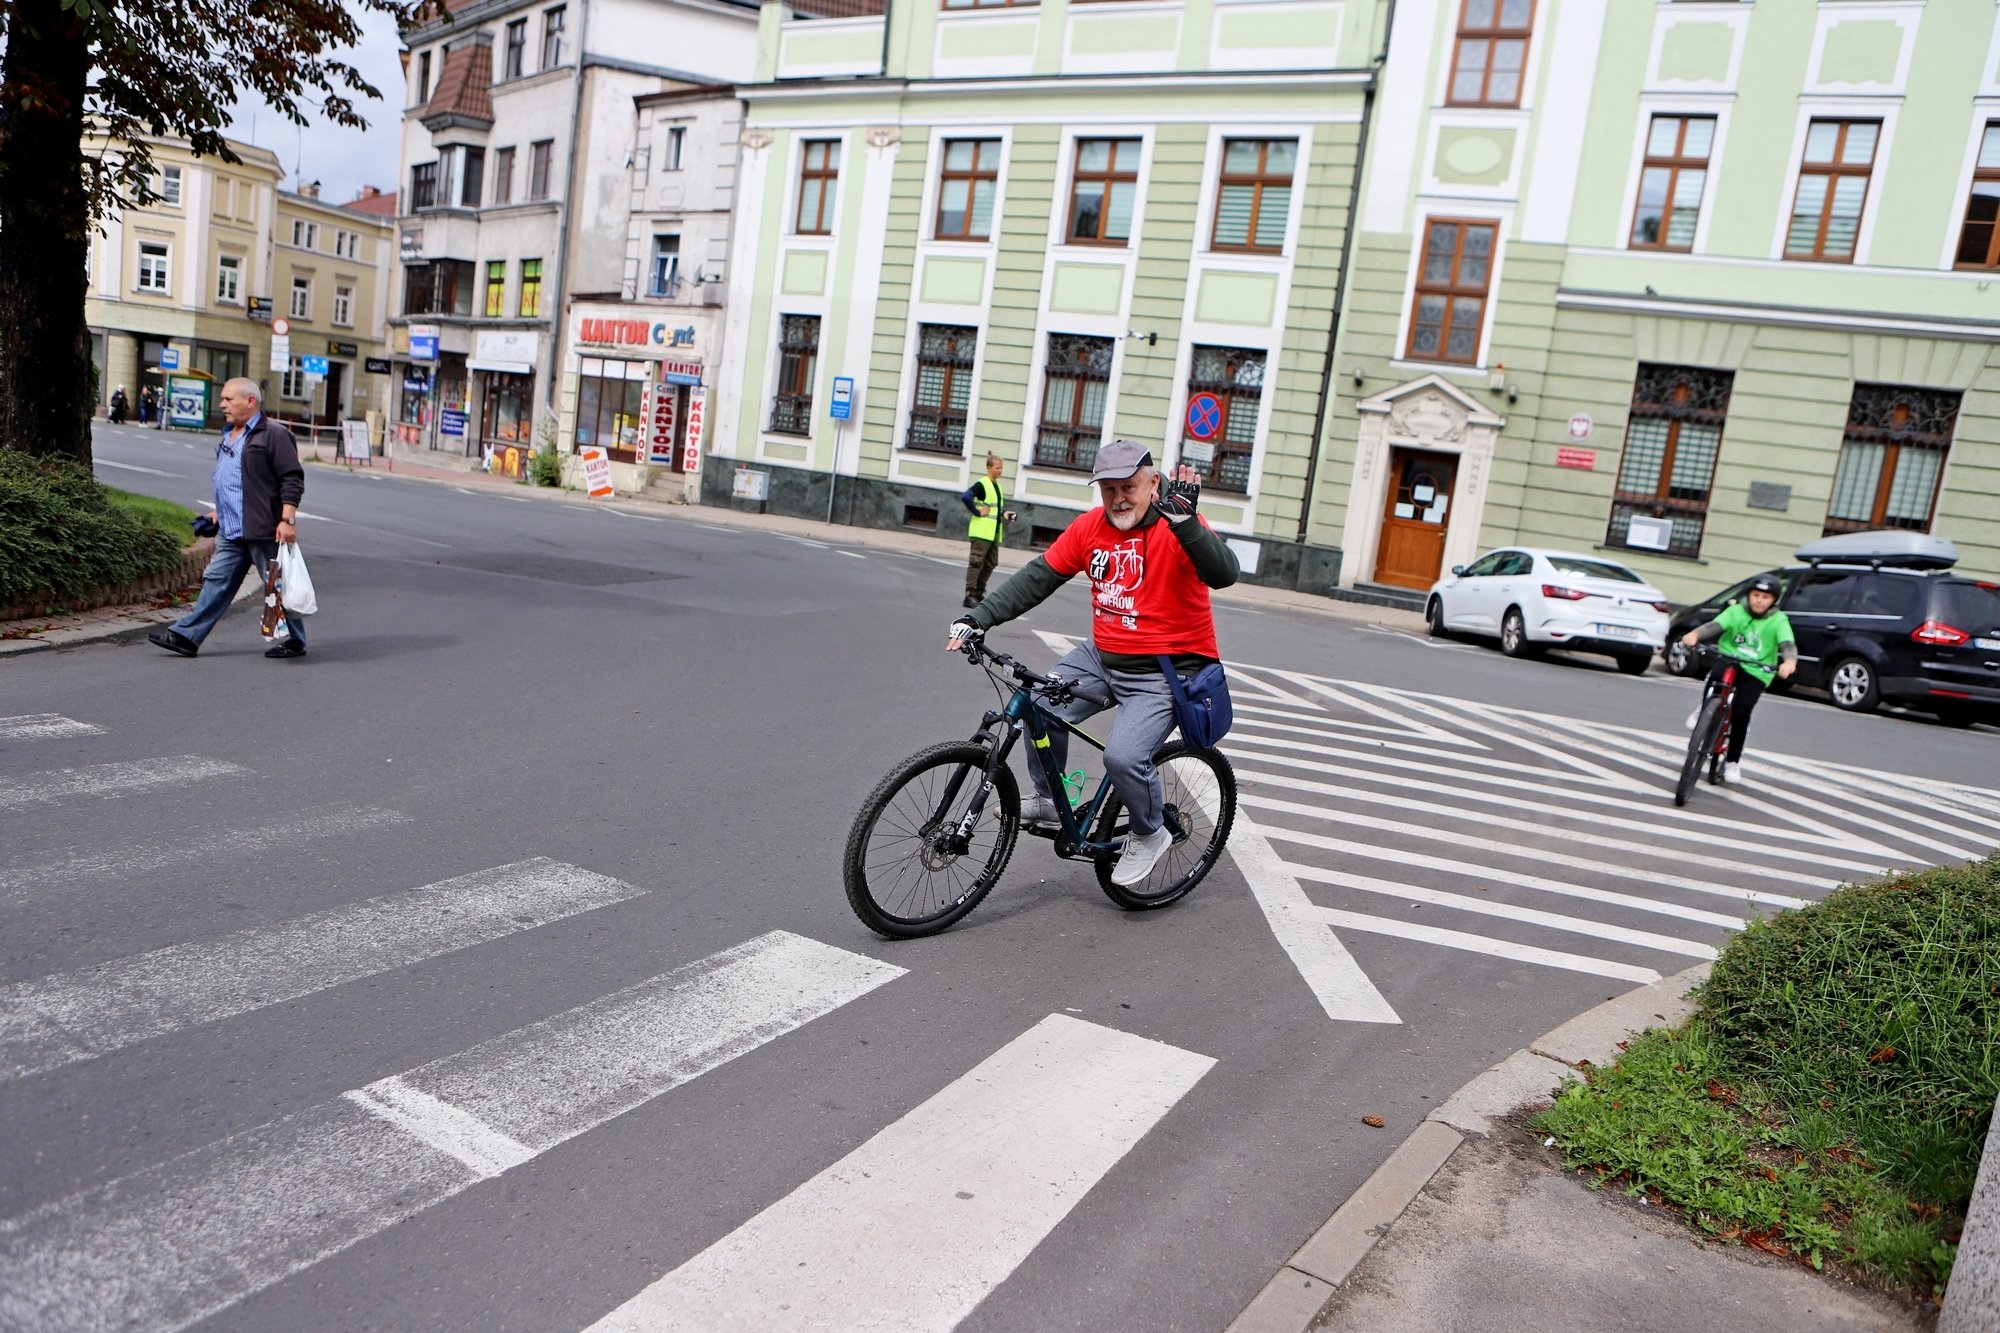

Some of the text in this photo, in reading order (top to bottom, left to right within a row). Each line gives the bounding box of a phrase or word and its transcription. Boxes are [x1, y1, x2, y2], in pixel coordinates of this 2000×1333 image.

[580, 318, 695, 348] KANTOR Cent
[667, 362, 700, 376] KANTOR
[637, 391, 649, 461] KANTOR
[652, 395, 674, 454] KANTOR
[685, 401, 703, 470] KANTOR
[586, 458, 609, 473] KANTOR
[1091, 548, 1110, 566] 20
[1090, 564, 1105, 580] LAT
[956, 809, 978, 838] FOX
[957, 896, 966, 905] DT
